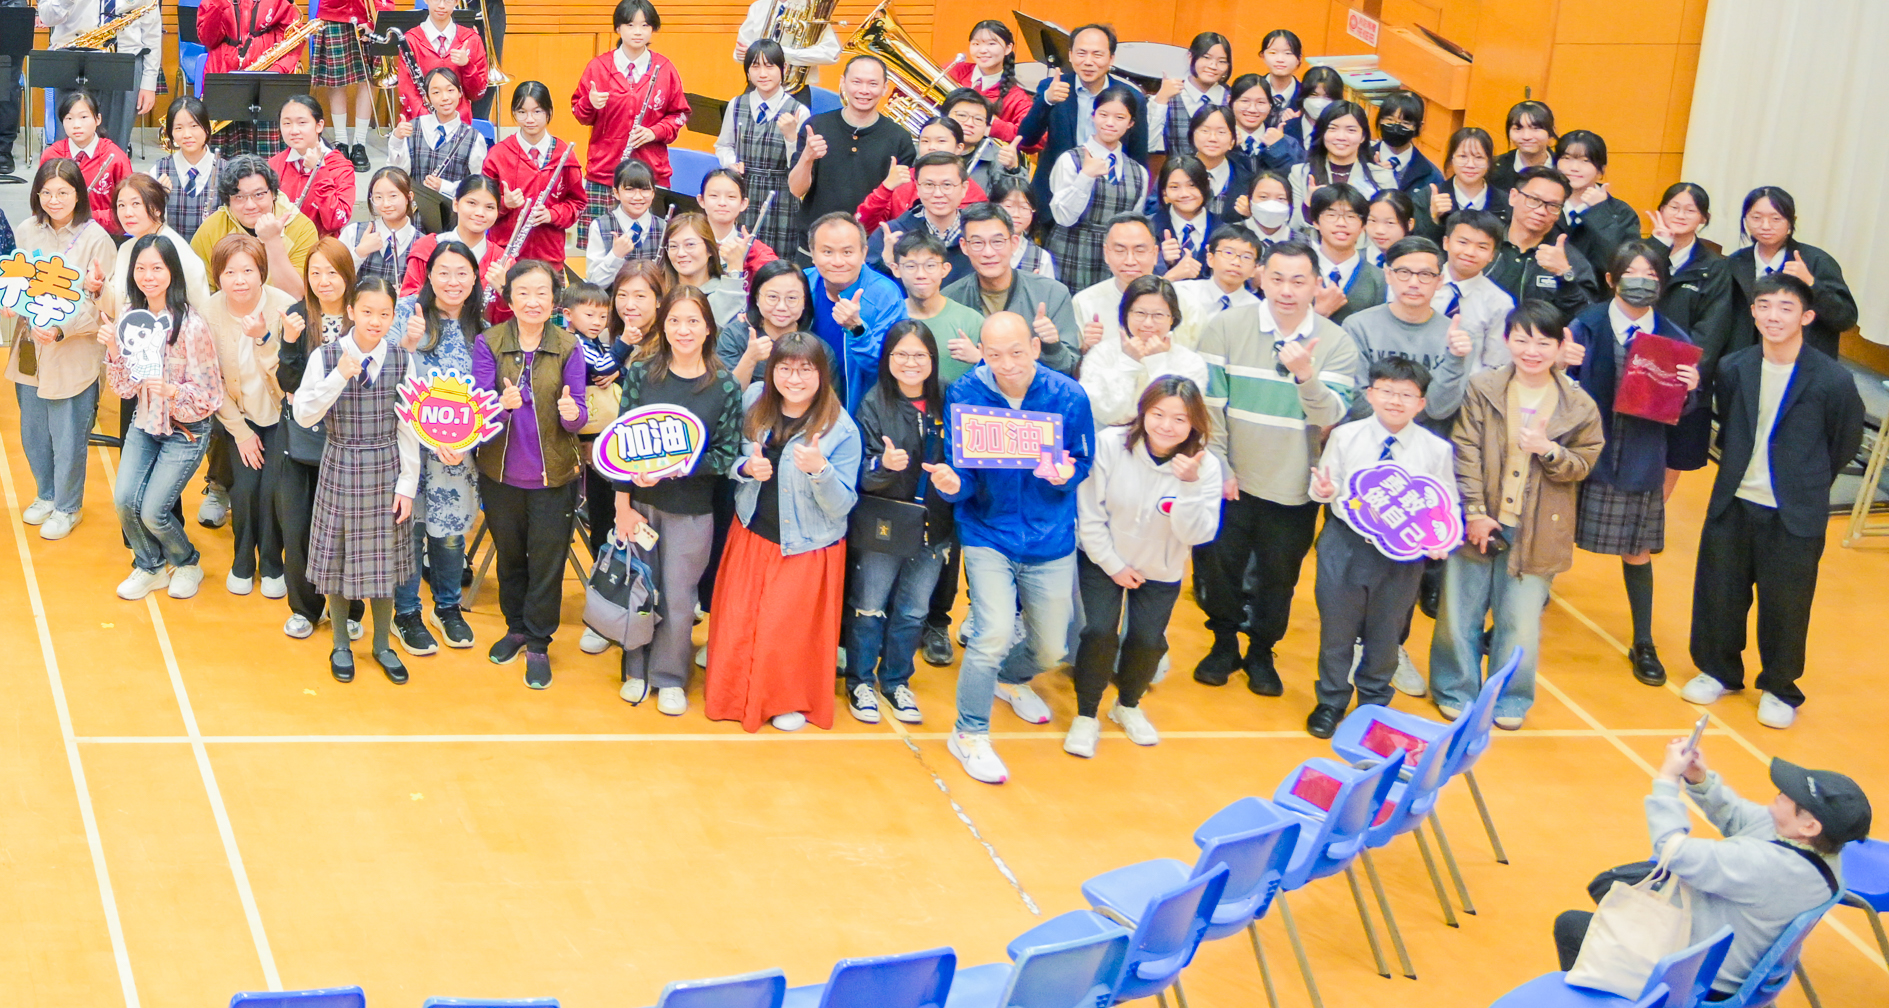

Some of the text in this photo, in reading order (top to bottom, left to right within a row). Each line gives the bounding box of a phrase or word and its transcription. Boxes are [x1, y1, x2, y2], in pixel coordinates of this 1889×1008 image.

[420, 405, 471, 425] NO.1
[965, 418, 1044, 455] 加油
[613, 415, 691, 461] 加油
[1362, 486, 1428, 548] 做自己
[1379, 472, 1427, 517] 勇敢
